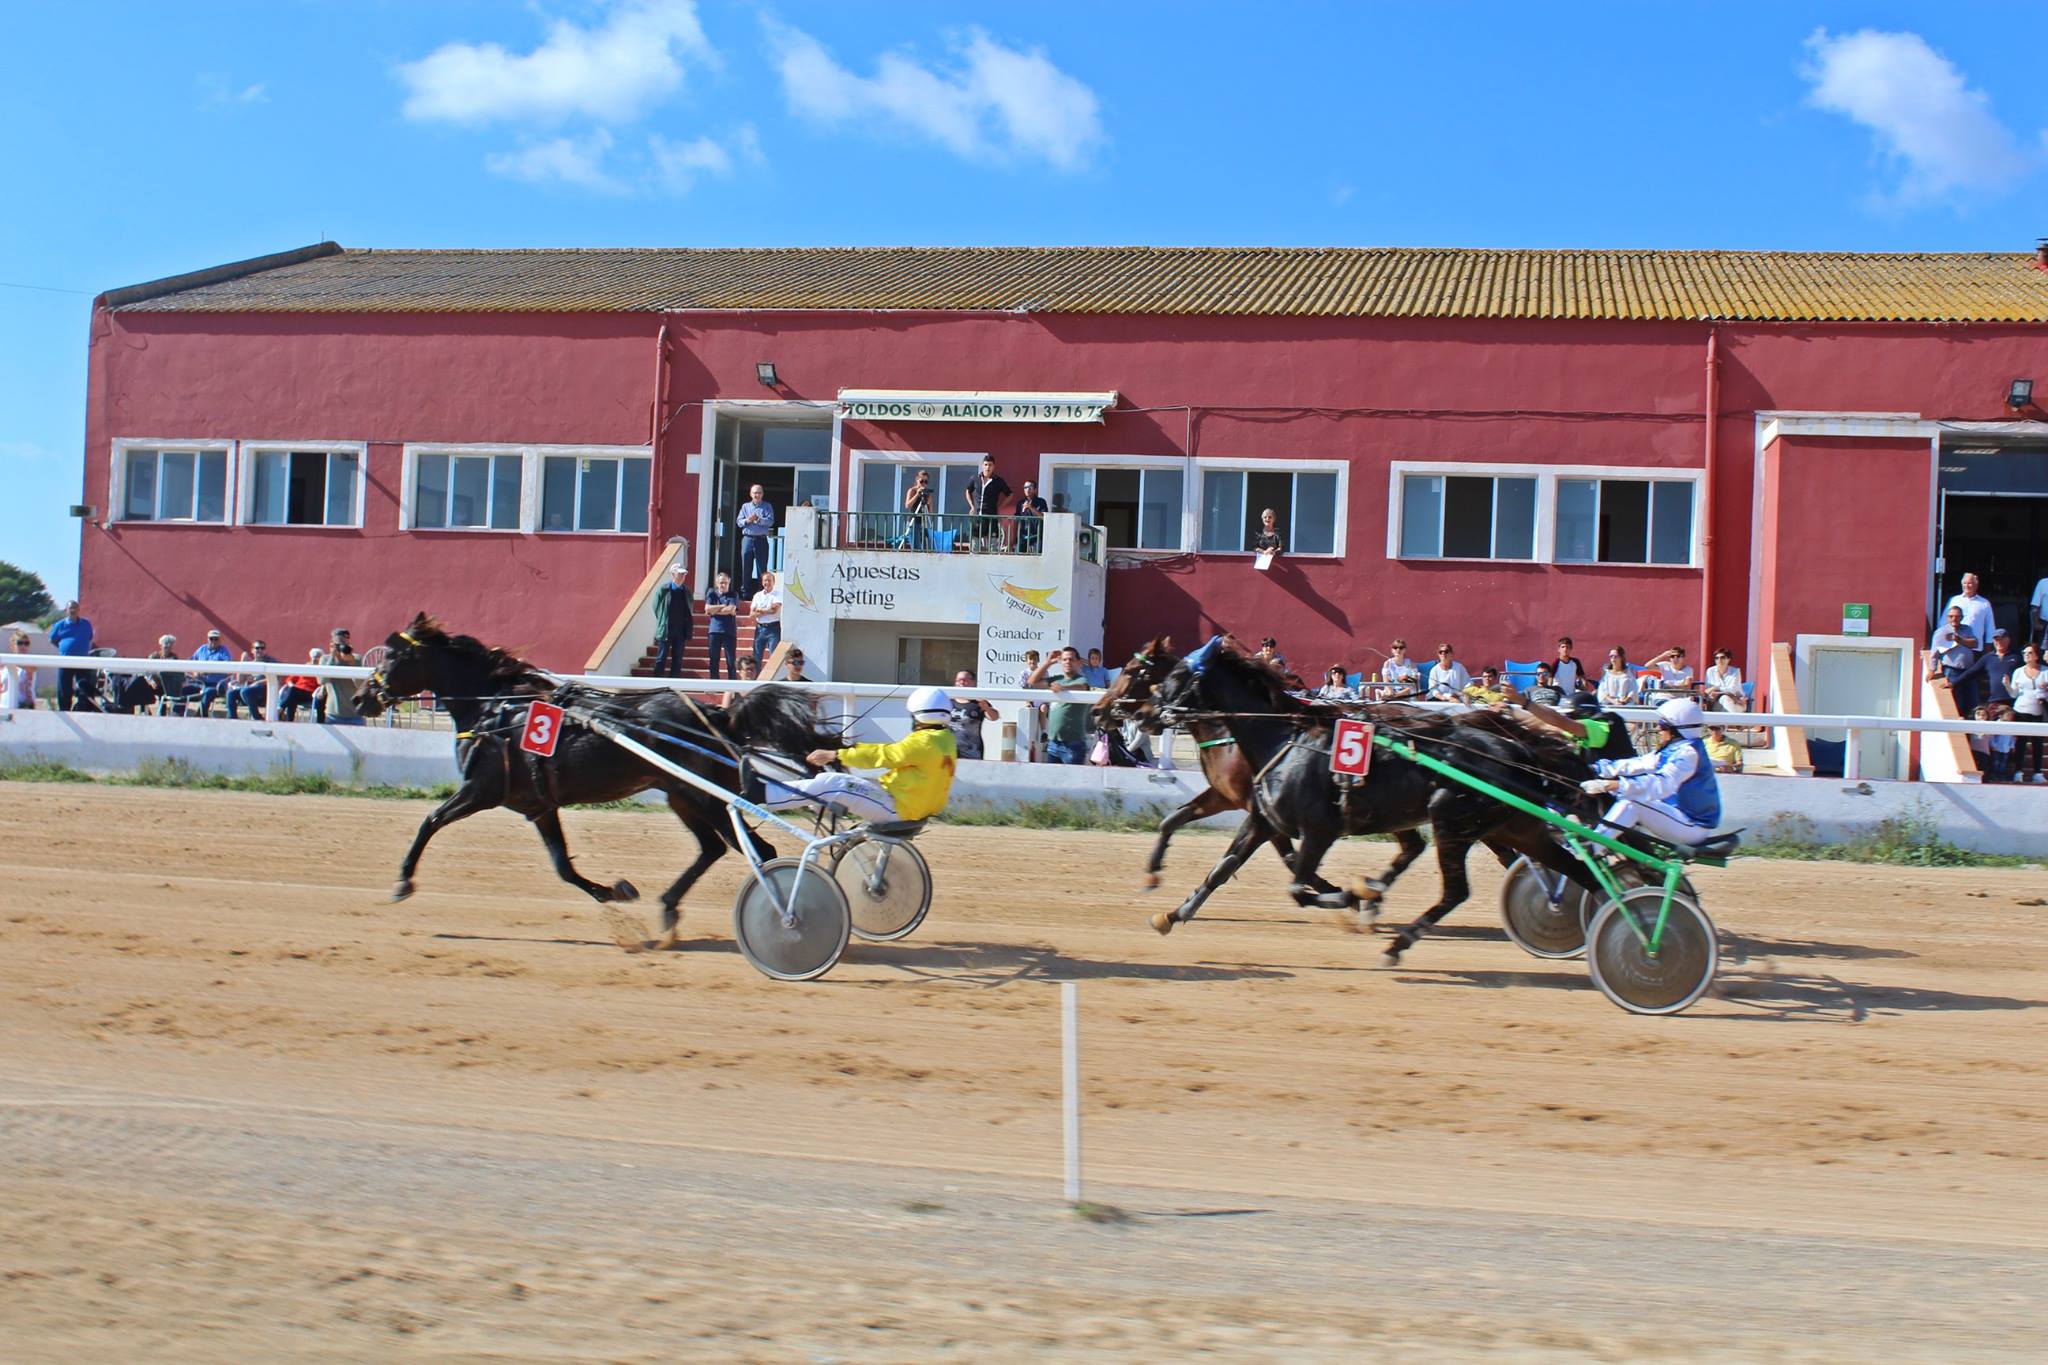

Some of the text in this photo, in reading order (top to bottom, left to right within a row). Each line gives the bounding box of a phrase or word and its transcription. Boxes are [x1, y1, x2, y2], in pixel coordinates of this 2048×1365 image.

[846, 403, 911, 416] TOLDOS
[942, 404, 1003, 417] ALAIOR
[1013, 405, 1037, 417] 971
[1044, 405, 1060, 417] 37
[1067, 405, 1082, 417] 16
[831, 563, 920, 582] Apuestas
[831, 588, 895, 610] Betting
[1006, 596, 1044, 620] upstairs
[986, 626, 1044, 640] Ganador
[985, 671, 1015, 685] Trio
[529, 714, 552, 744] 3
[1339, 730, 1364, 765] 5
